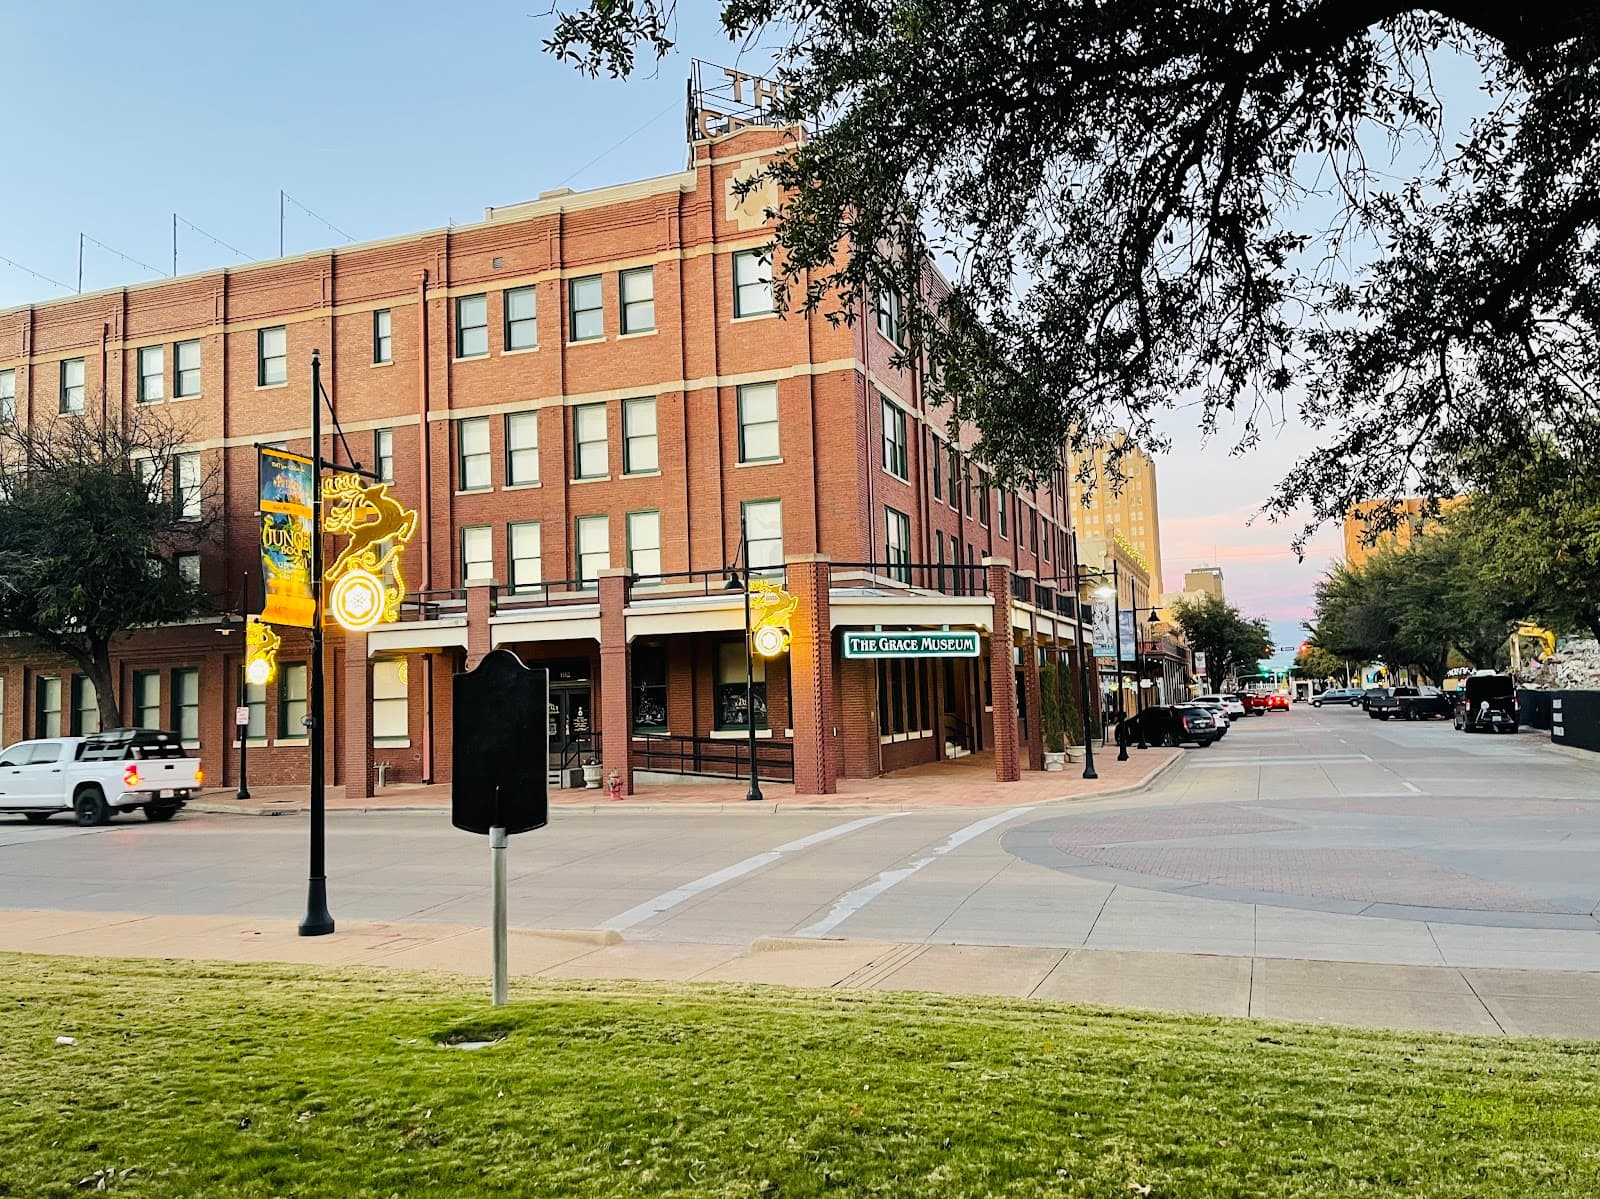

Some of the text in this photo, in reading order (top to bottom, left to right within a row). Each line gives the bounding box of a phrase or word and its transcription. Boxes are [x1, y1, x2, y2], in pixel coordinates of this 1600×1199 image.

[850, 637, 974, 651] THE GRACE MUSEUM
